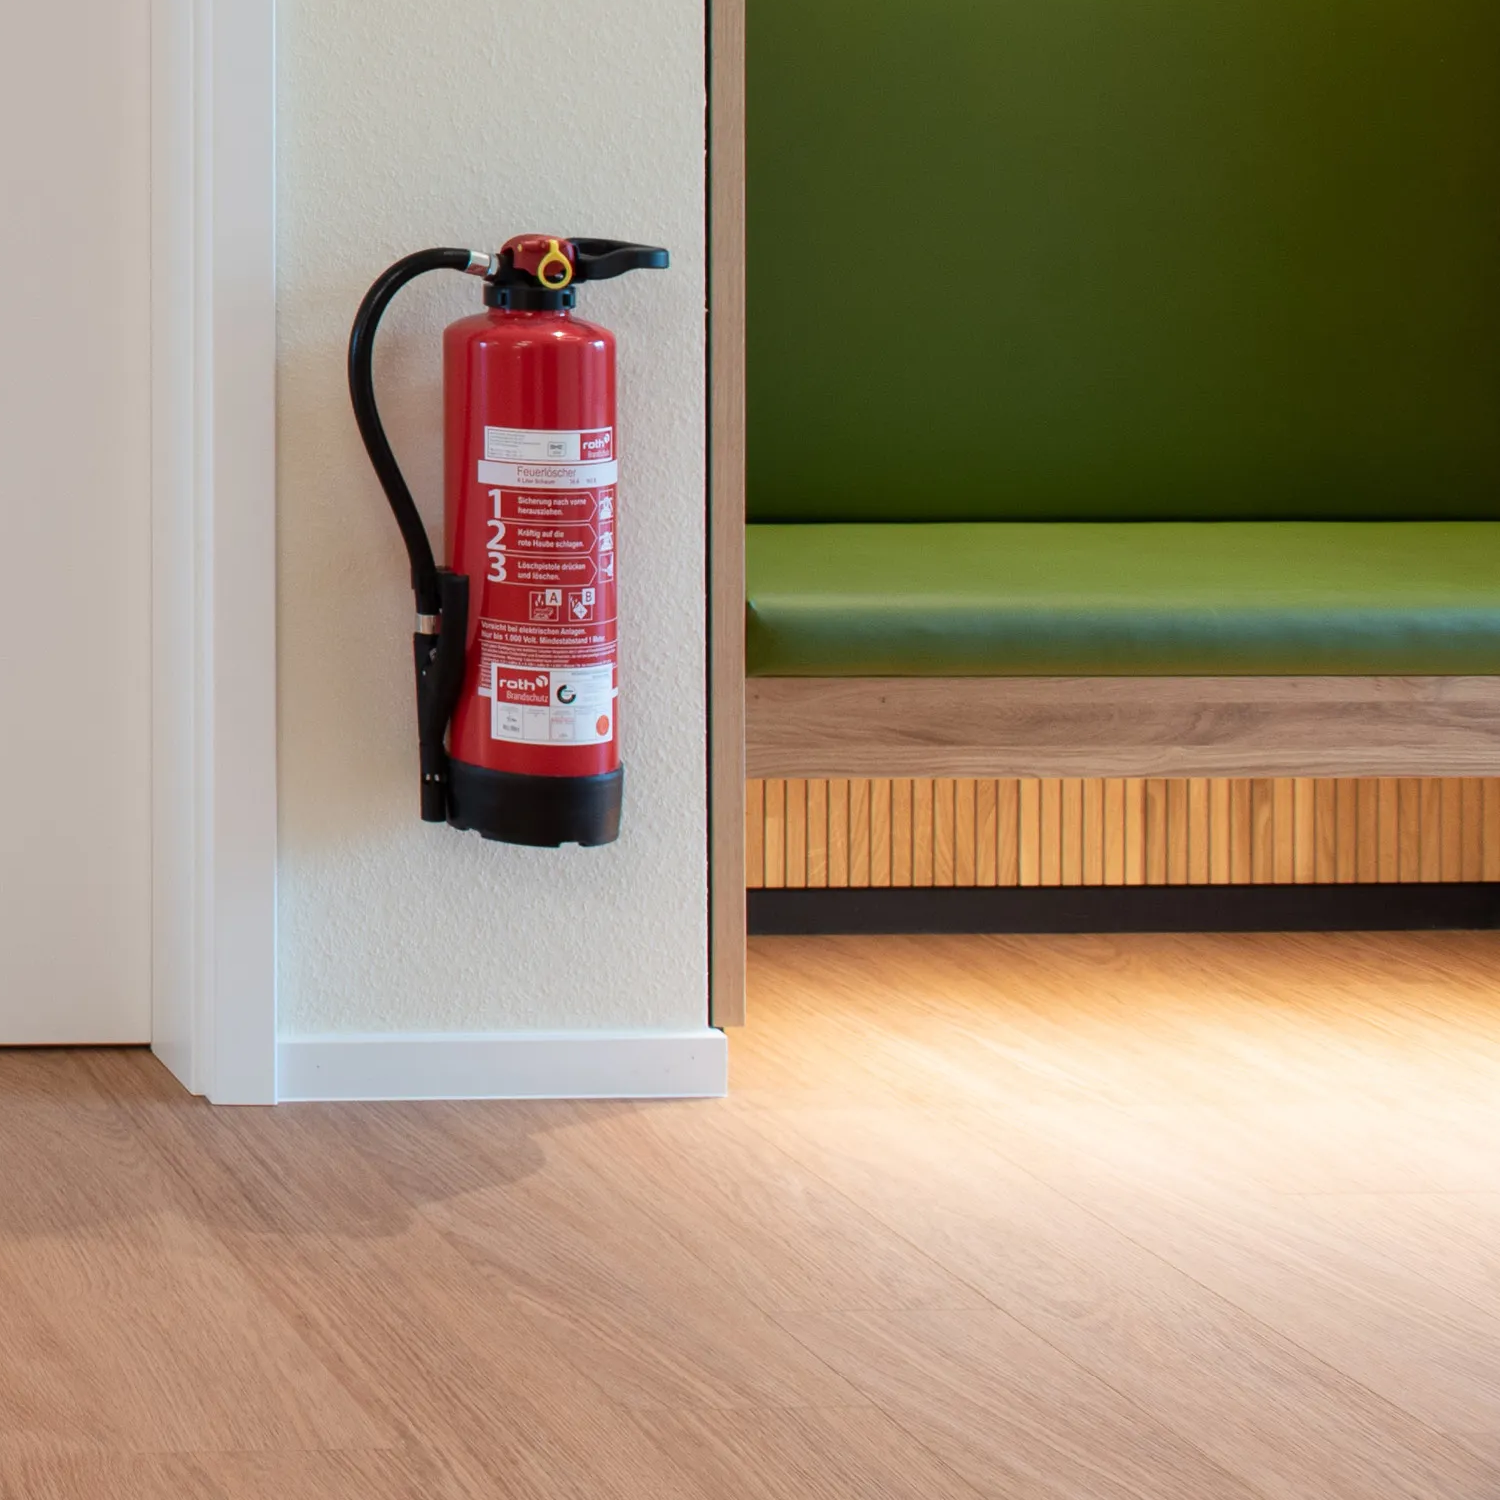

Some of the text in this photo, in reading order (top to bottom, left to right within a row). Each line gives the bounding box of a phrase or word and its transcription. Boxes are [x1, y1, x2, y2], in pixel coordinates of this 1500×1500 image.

[582, 438, 605, 450] roth
[516, 465, 577, 477] Feuerlöscher
[488, 488, 501, 519] 1
[517, 496, 587, 507] Sicherung nach vorne
[517, 506, 563, 516] herausziehen.
[486, 519, 506, 551] 2
[517, 528, 564, 539] Kräftig auf die
[517, 539, 584, 550] rote Haube schlagen.
[487, 551, 507, 582] 3
[517, 561, 586, 572] Löschpistole drücken
[517, 571, 560, 581] und löschen.
[549, 591, 559, 603] A
[585, 591, 593, 603] B
[481, 621, 507, 633] Vorsicht
[507, 624, 518, 633] bei
[519, 626, 560, 636] elektrischen
[539, 635, 588, 645] Mindestabstand
[499, 677, 536, 691] roth
[506, 689, 549, 703] Brandschutz
